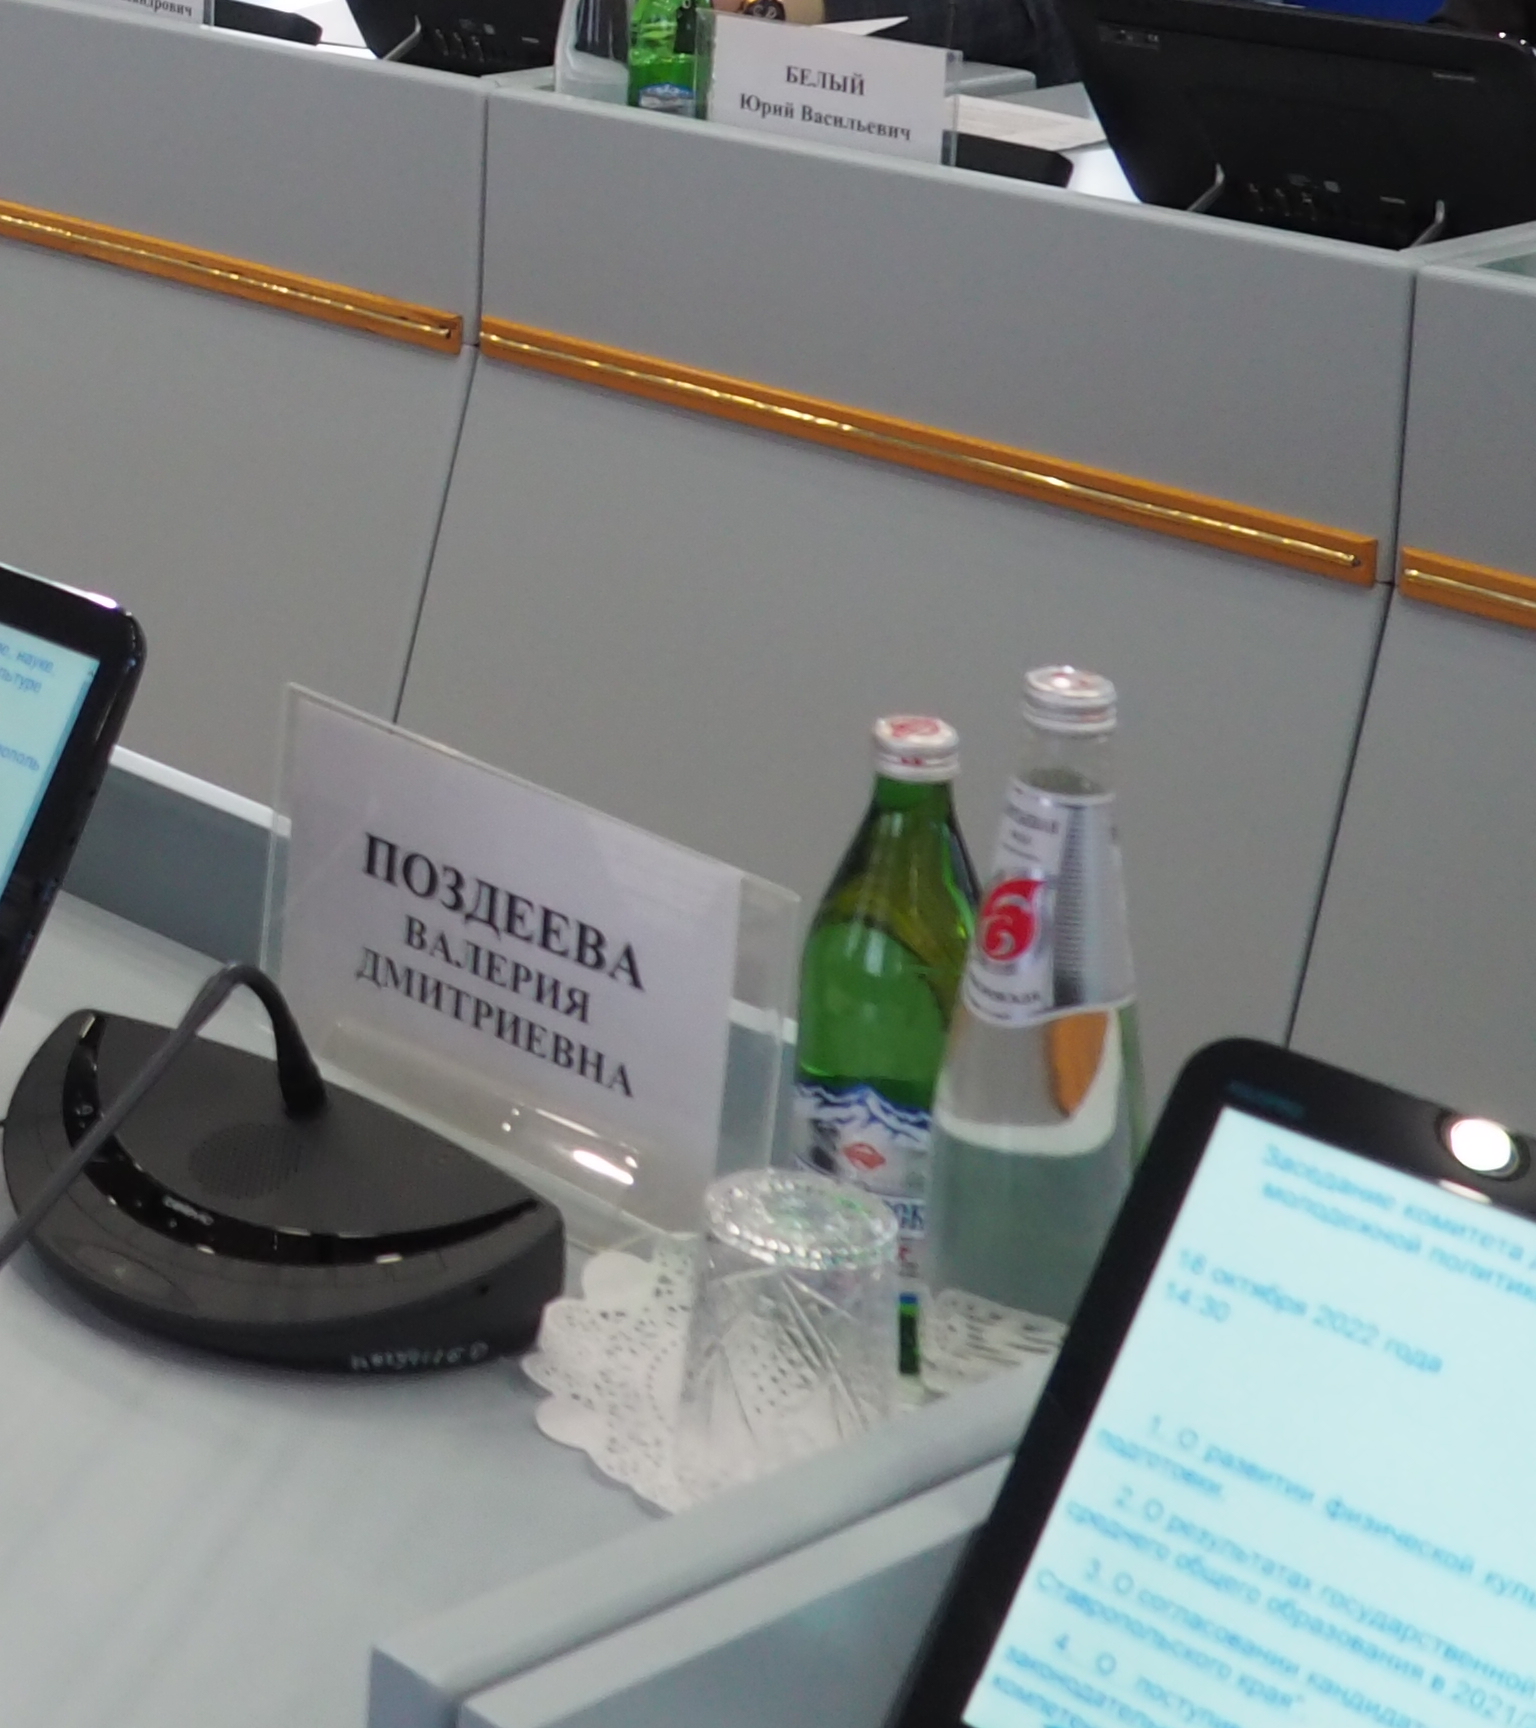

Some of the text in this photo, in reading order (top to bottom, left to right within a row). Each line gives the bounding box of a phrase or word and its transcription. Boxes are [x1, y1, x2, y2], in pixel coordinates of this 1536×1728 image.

[740, 93, 911, 141] Юрий Васильевич
[785, 65, 865, 96] БЕЛЫЙ
[365, 833, 646, 992] ПОЗДЕЕВА
[404, 914, 590, 1024] ВАЛЕРИЯ
[356, 946, 634, 1097] ДМИТРИЕВНА
[1311, 1302, 1382, 1348] 2022
[1322, 1492, 1478, 1580] физической
